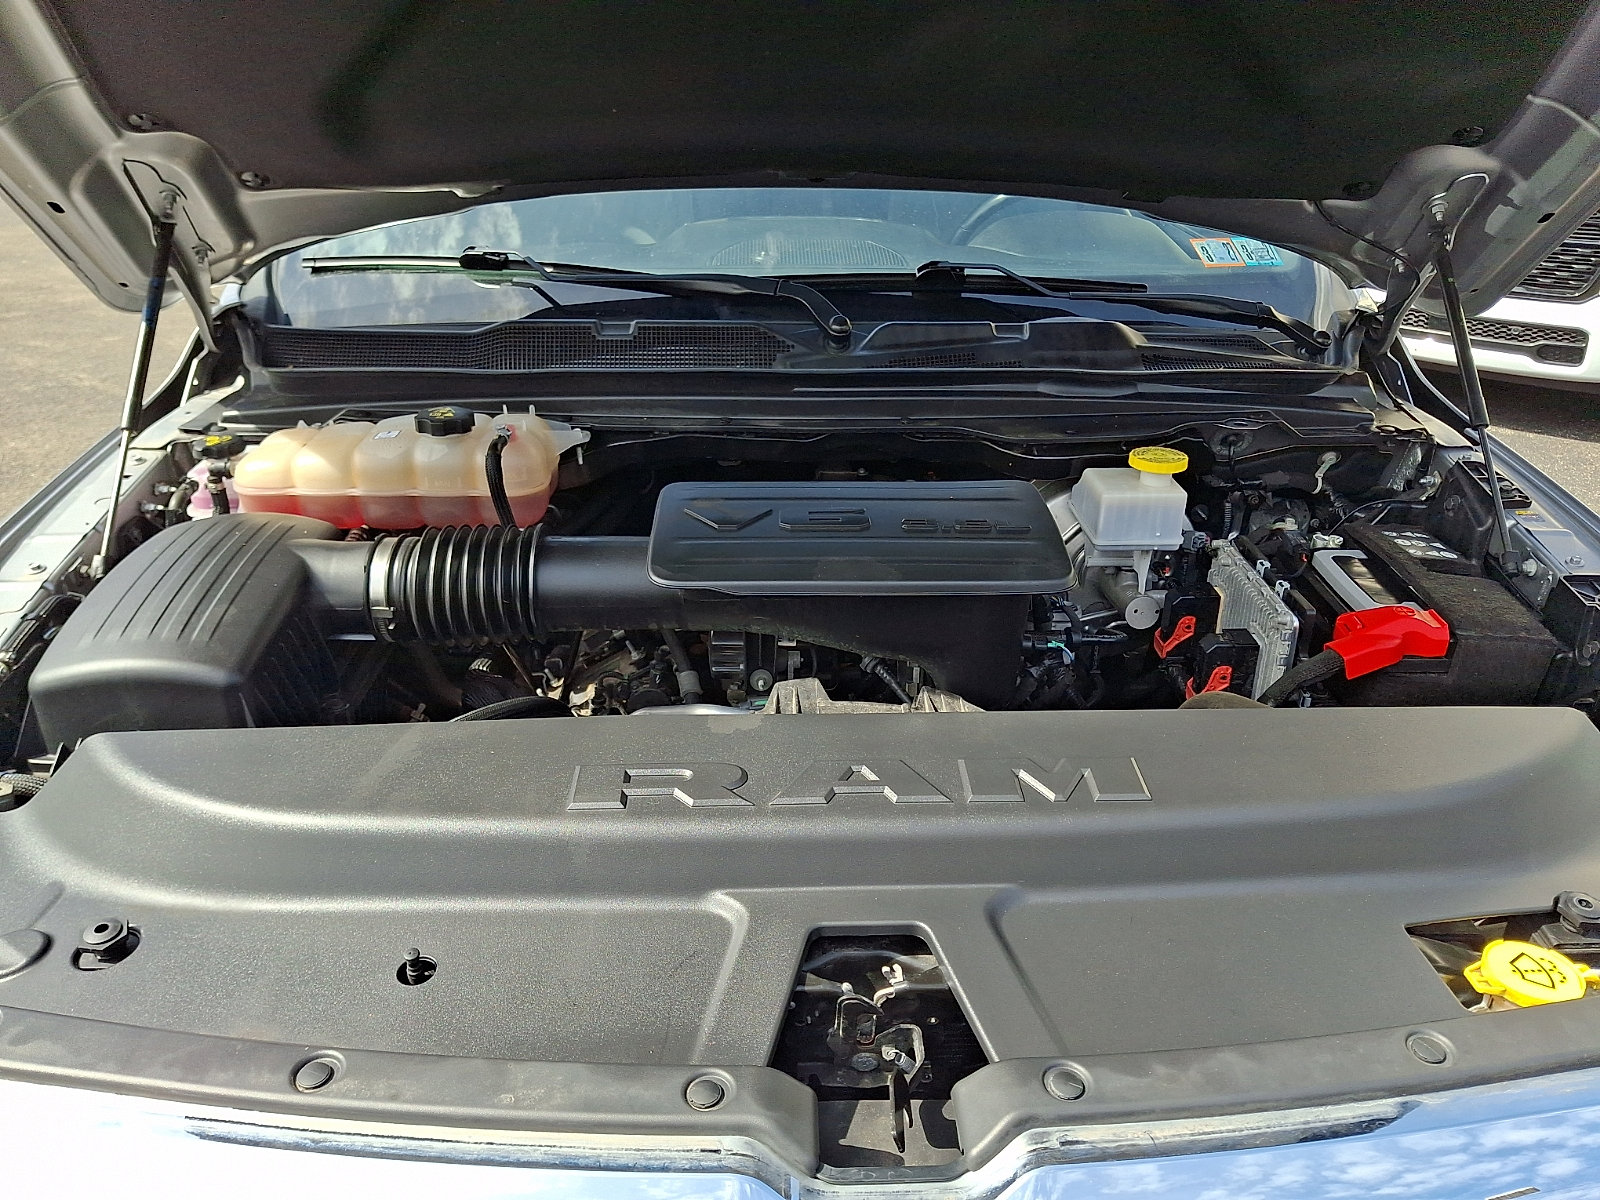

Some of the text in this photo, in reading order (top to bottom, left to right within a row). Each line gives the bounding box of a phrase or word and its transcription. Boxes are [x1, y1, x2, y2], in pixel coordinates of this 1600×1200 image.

[1200, 245, 1214, 263] 3
[1241, 244, 1255, 261] 3
[683, 506, 872, 532] V6
[566, 757, 1153, 811] RAM
